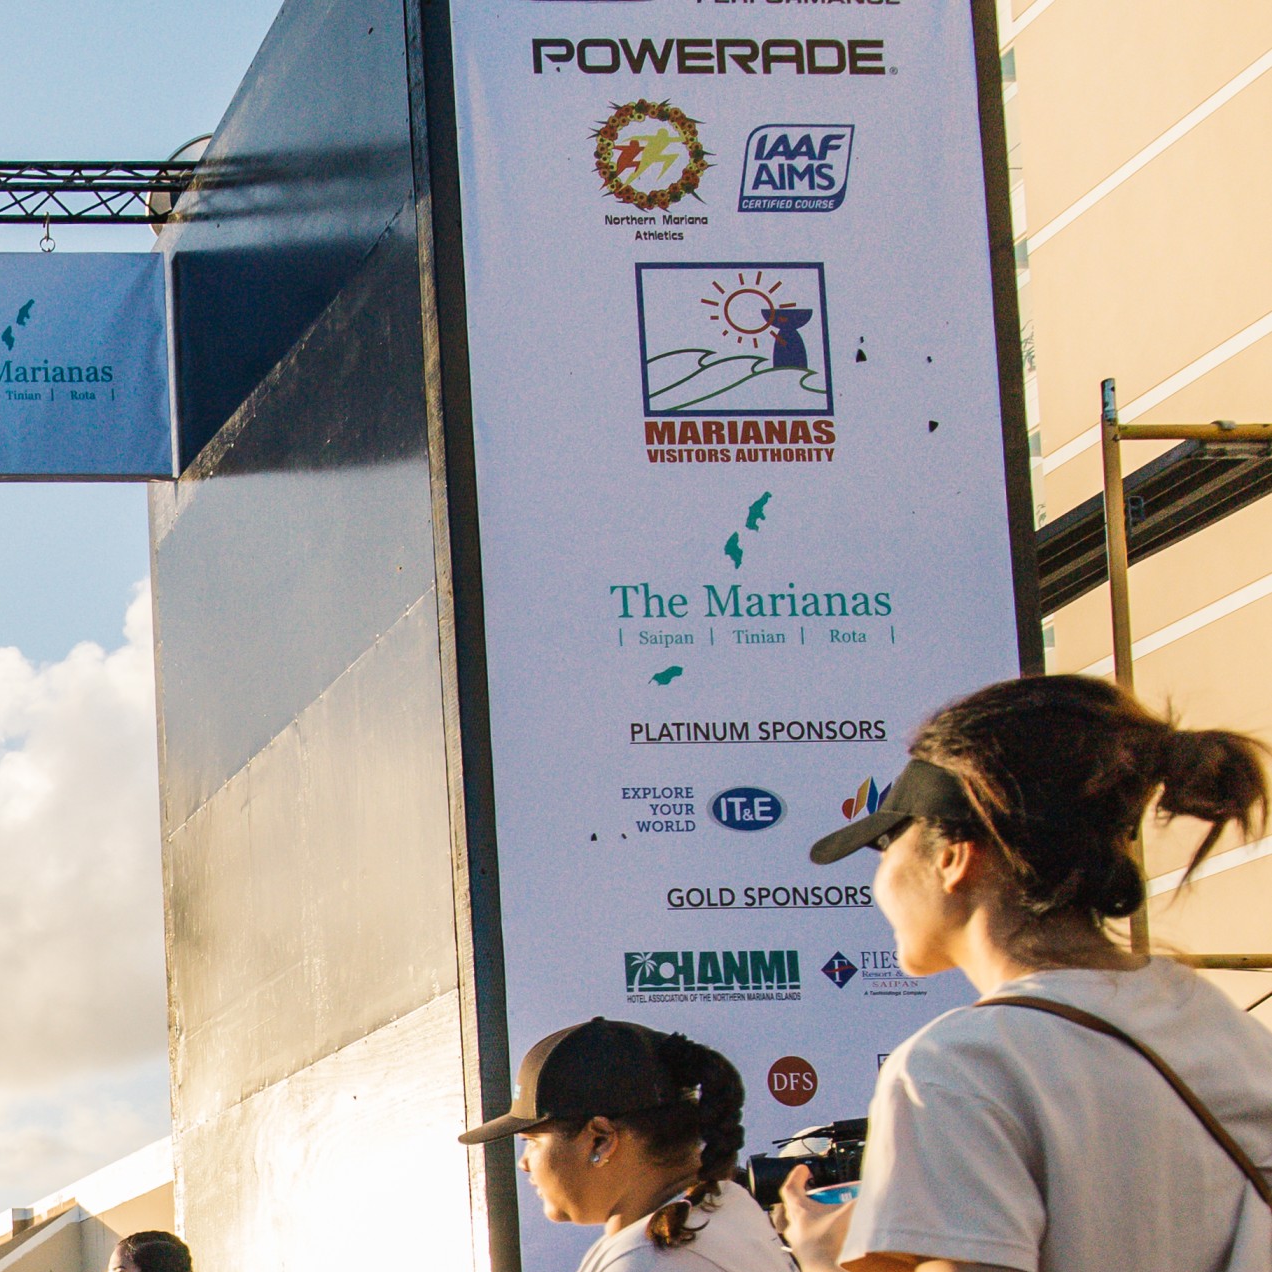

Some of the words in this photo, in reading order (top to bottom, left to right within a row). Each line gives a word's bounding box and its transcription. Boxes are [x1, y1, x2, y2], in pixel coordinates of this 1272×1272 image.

[532, 38, 886, 75] POWERADE
[755, 132, 845, 160] IAAF
[752, 163, 836, 191] AIMS
[741, 199, 792, 210] CERTIFIED
[795, 199, 835, 210] COURSE
[604, 214, 656, 226] Northern
[662, 214, 708, 225] Mariana
[634, 230, 684, 241] Athletics
[5, 390, 42, 400] Tinian
[70, 390, 96, 400] Rota
[644, 420, 836, 445] MARIANAS
[646, 448, 730, 463] VISITORS
[734, 448, 835, 463] AUTHORITY
[609, 584, 690, 619] The
[703, 583, 892, 618] Marianas
[638, 629, 695, 648] Saipan
[732, 629, 786, 645] Tinian
[829, 629, 867, 644] Rota
[630, 721, 750, 742] PLATINUM
[758, 720, 887, 742] SPONSORS
[621, 787, 694, 800] EXPLORE
[649, 803, 695, 816] YOUR
[719, 797, 772, 824] IT&E
[636, 819, 697, 833] WORLD
[667, 887, 736, 909] GOLD
[743, 886, 873, 907] SPONSORS
[668, 950, 800, 991] HANMI
[872, 980, 919, 988] SAIPAN
[627, 994, 647, 1003] HOTEL
[649, 994, 688, 1003] ASSOCIATION
[690, 994, 697, 1002] OF
[698, 994, 711, 1002] THE
[712, 993, 745, 1002] NORTHERN
[747, 993, 774, 1001] MARIANA
[775, 992, 801, 1001] ISLANDS
[773, 1071, 813, 1092] DFS
